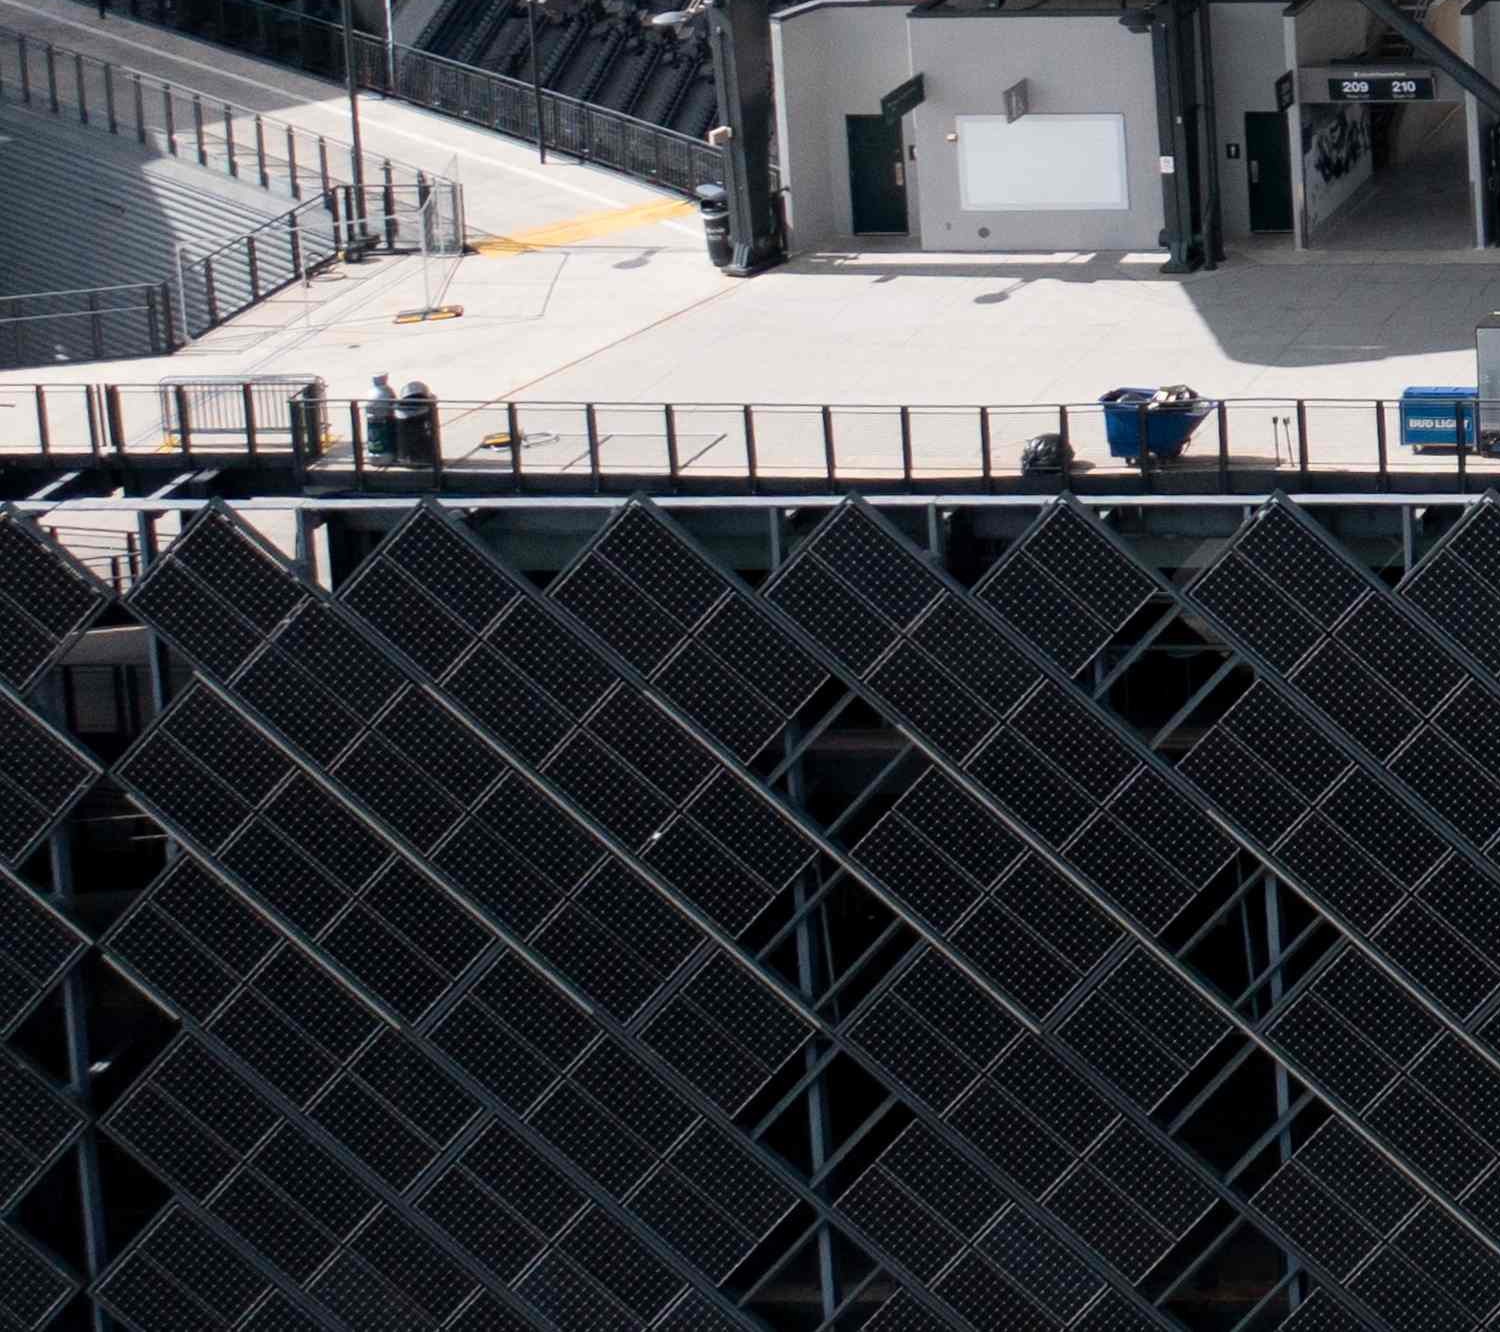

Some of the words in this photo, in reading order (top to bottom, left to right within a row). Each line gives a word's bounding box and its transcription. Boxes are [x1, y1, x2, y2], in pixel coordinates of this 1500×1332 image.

[1342, 81, 1369, 93] 209
[1391, 81, 1417, 93] 210
[1409, 419, 1434, 428] BUD
[1435, 419, 1468, 428] LIGT
